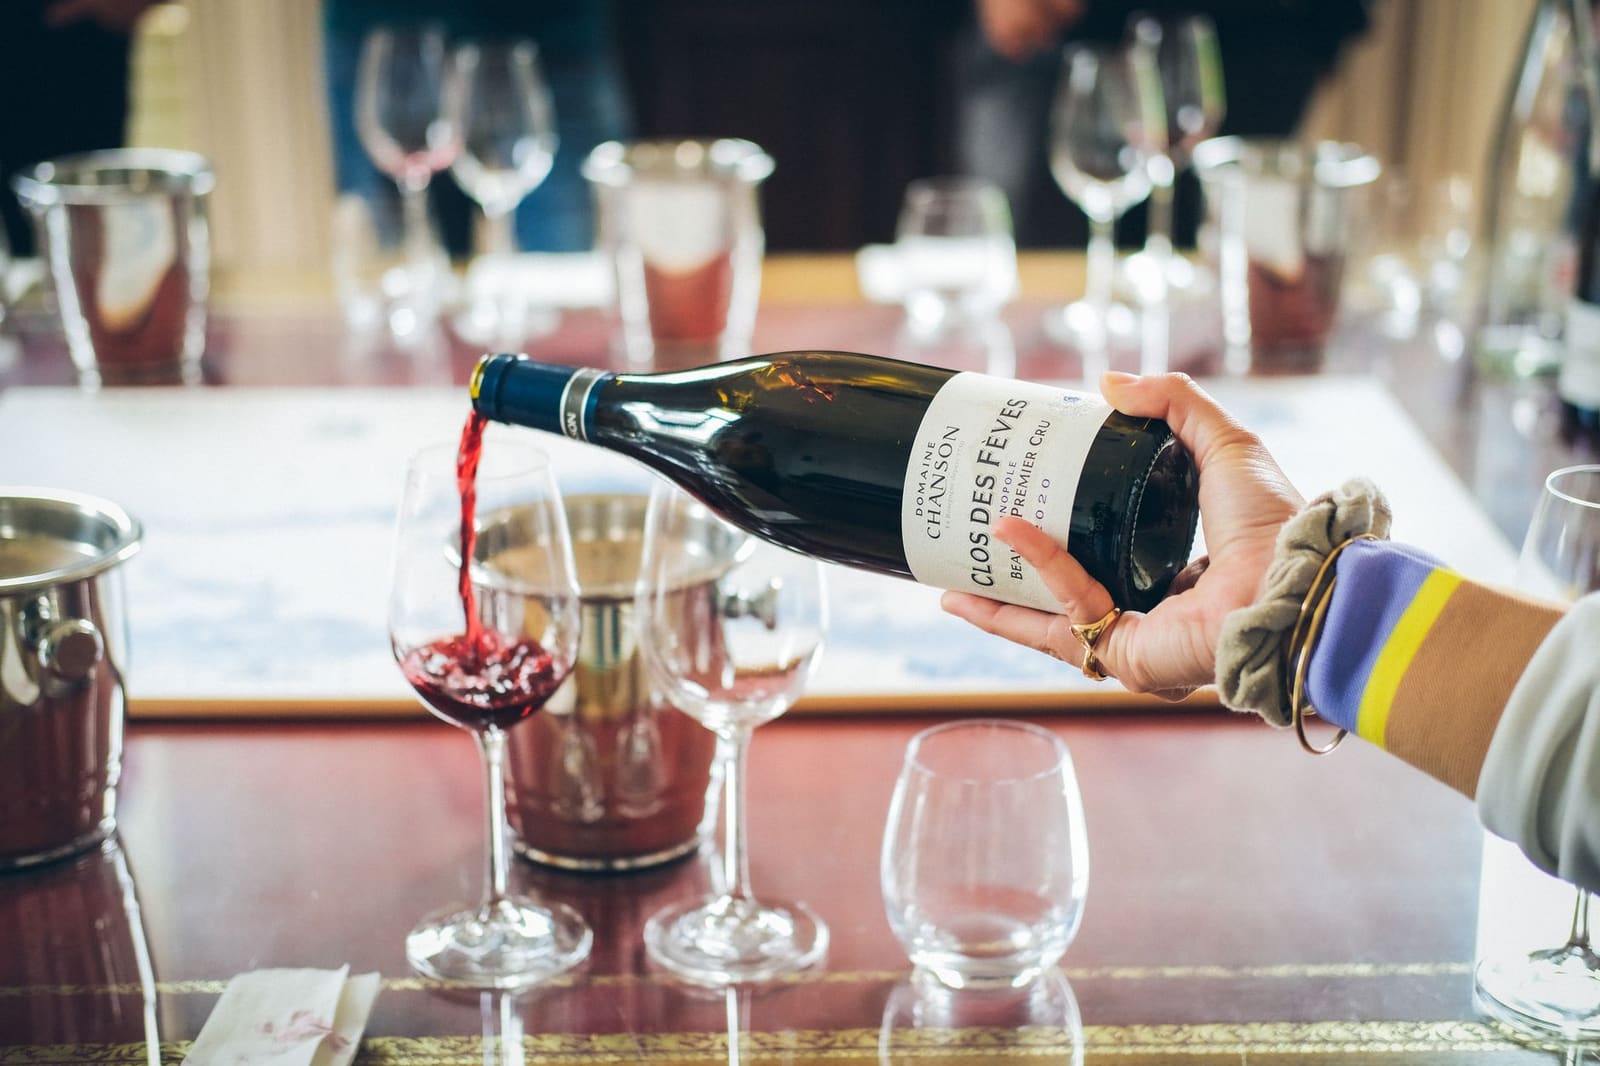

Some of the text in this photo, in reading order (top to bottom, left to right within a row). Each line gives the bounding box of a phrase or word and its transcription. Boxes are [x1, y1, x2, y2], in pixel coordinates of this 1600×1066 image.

[915, 441, 936, 517] DOMAINE
[926, 425, 960, 540] CHANSON
[969, 398, 1029, 588] CLOS DES FÈVES
[999, 461, 1017, 518] NOPOLE
[1009, 451, 1039, 519] PREMIER
[1035, 478, 1051, 530] 020
